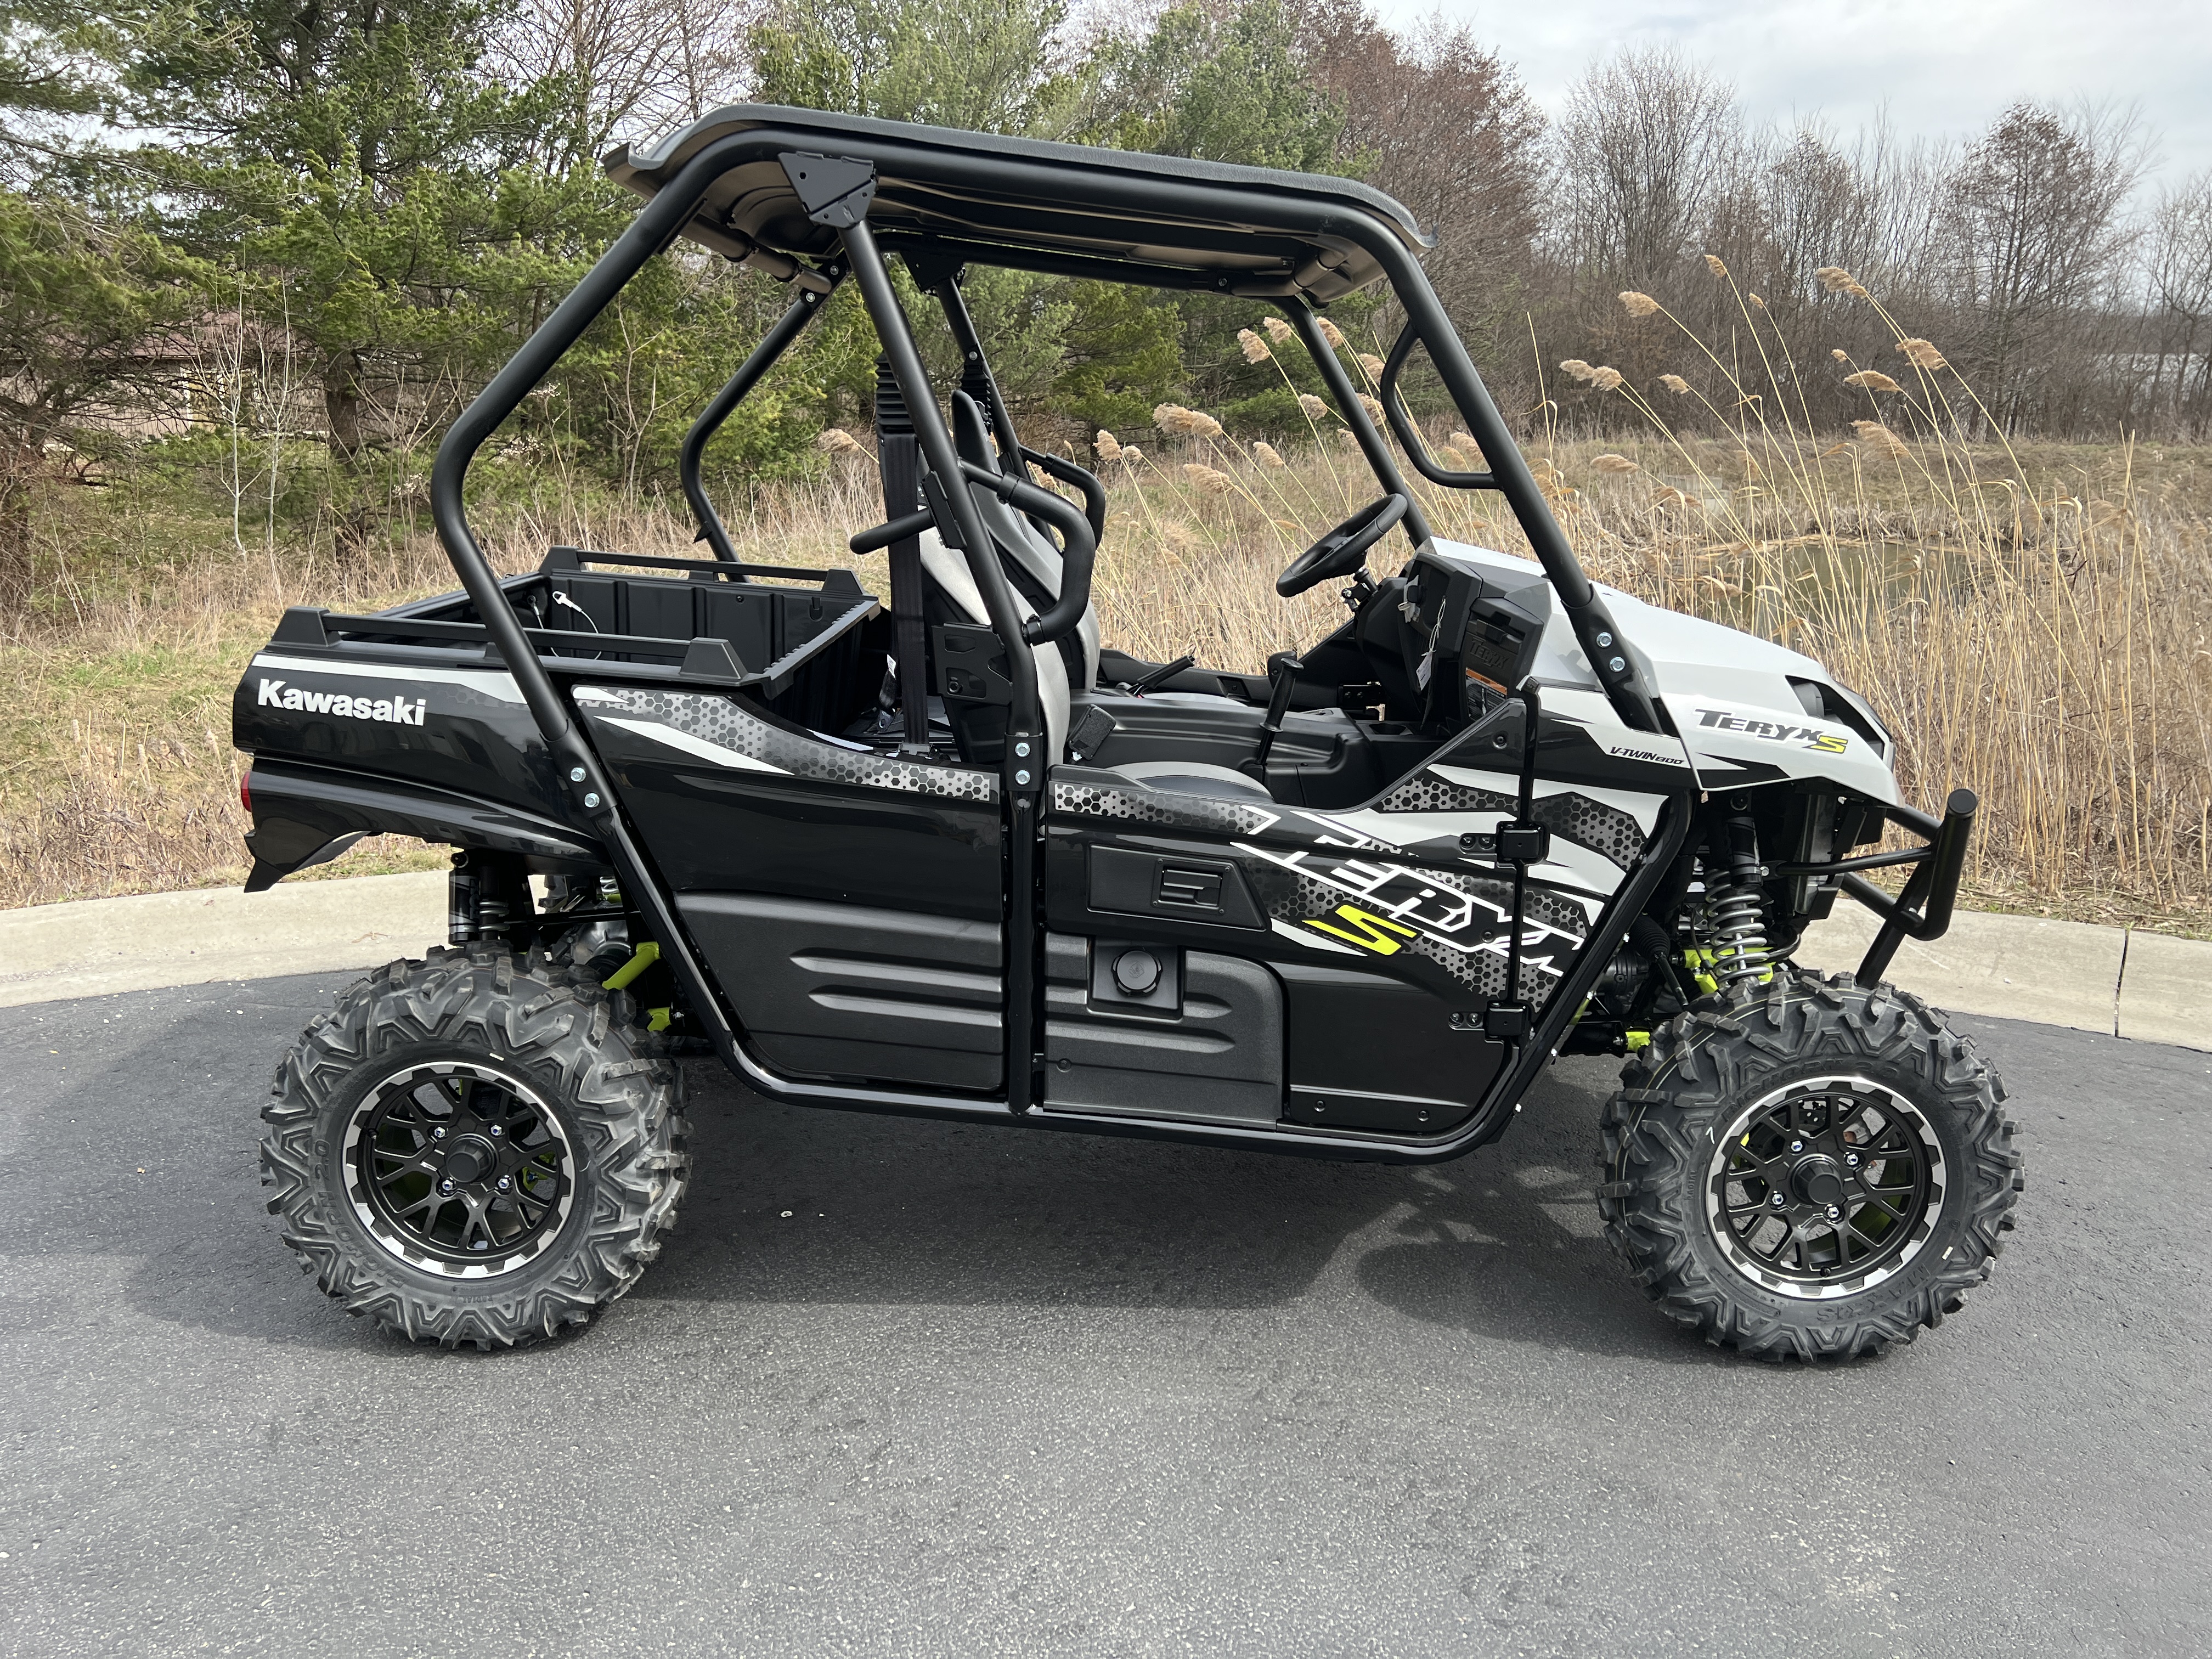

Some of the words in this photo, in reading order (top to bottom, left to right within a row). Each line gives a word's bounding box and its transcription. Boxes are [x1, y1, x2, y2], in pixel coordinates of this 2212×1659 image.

[258, 678, 426, 726] Kawasaki
[1301, 905, 1418, 956] S
[315, 1139, 330, 1180] 2.0
[318, 1191, 408, 1289] BIGHORN
[1816, 1263, 1931, 1322] MAXXIS
